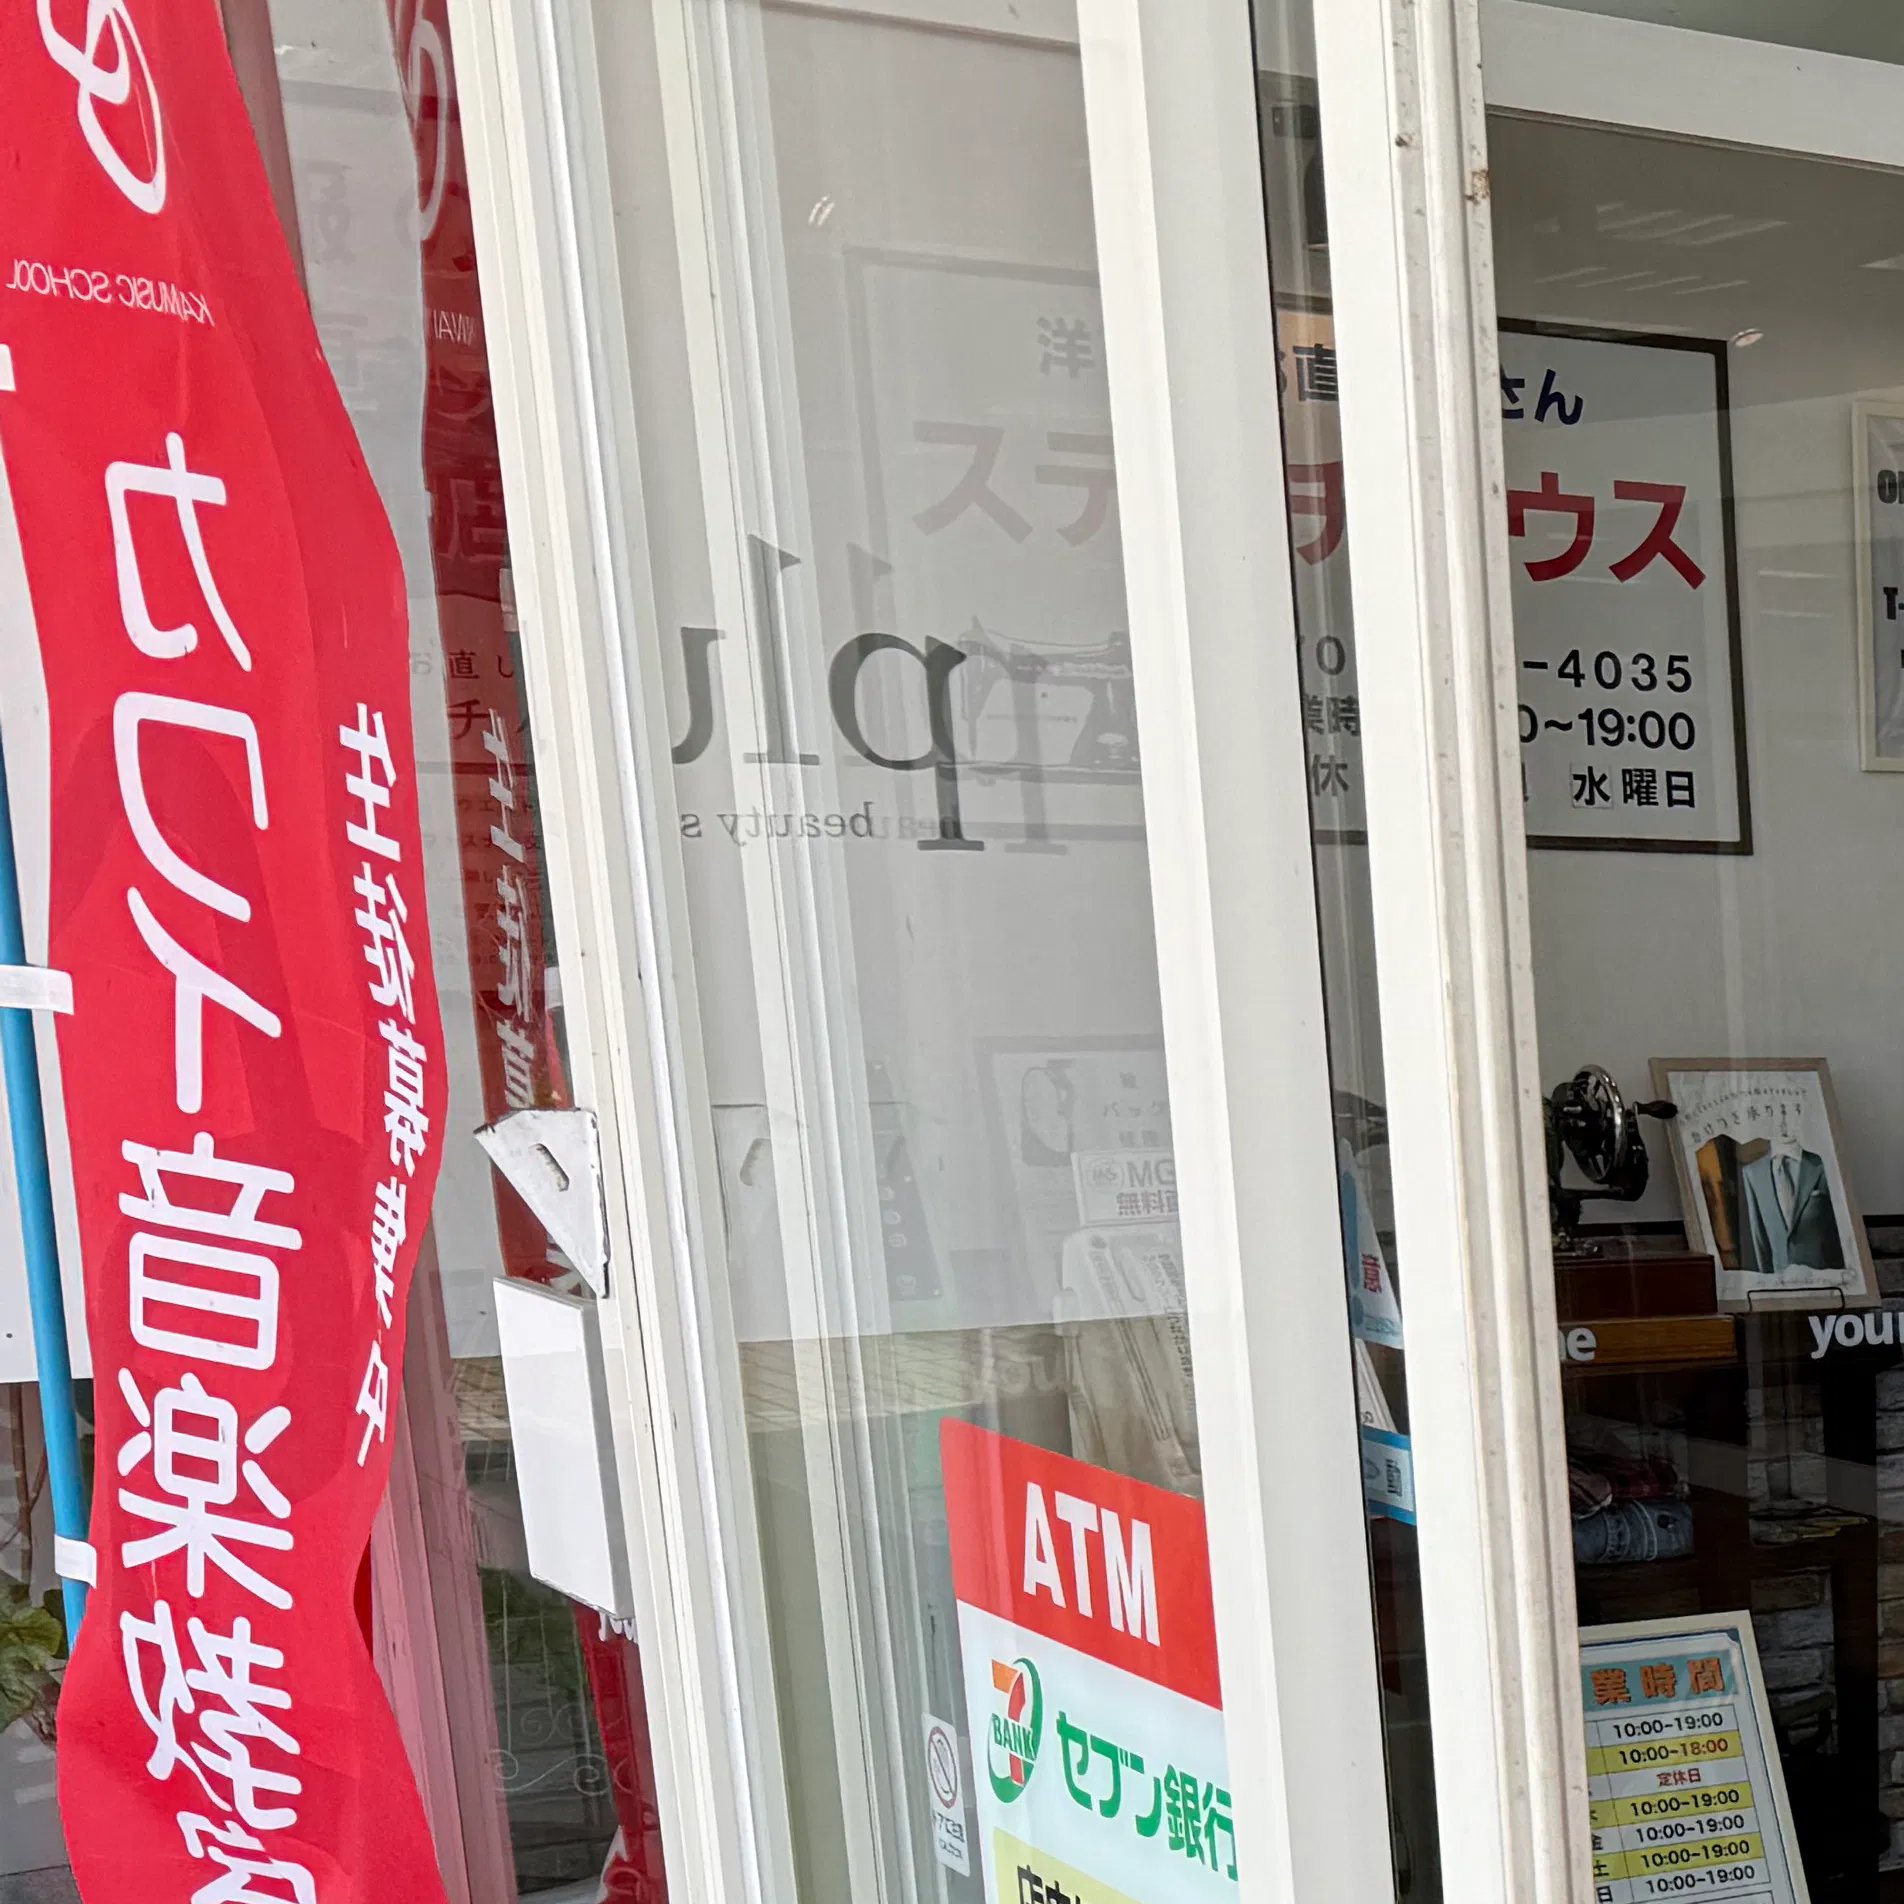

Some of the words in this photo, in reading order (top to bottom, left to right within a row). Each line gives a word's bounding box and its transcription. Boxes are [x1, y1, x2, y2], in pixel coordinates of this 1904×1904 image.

[1571, 765, 1697, 809] 水曜日
[1021, 1480, 1161, 1647] ATM
[1591, 1656, 1726, 1706] 業時間
[991, 1712, 1037, 1761] BANK
[1612, 1712, 1724, 1740] 10:00-19:00
[1618, 1737, 1729, 1765] 10:00-18:00
[1656, 1767, 1703, 1788] 定休日
[1055, 1709, 1239, 1881] セブン銀行
[1630, 1789, 1740, 1817] 10:00-19:00
[1636, 1814, 1746, 1844] 10:00-19:00
[1640, 1840, 1751, 1868] 10:00-19:00
[1645, 1865, 1756, 1895] 10:00-19:00
